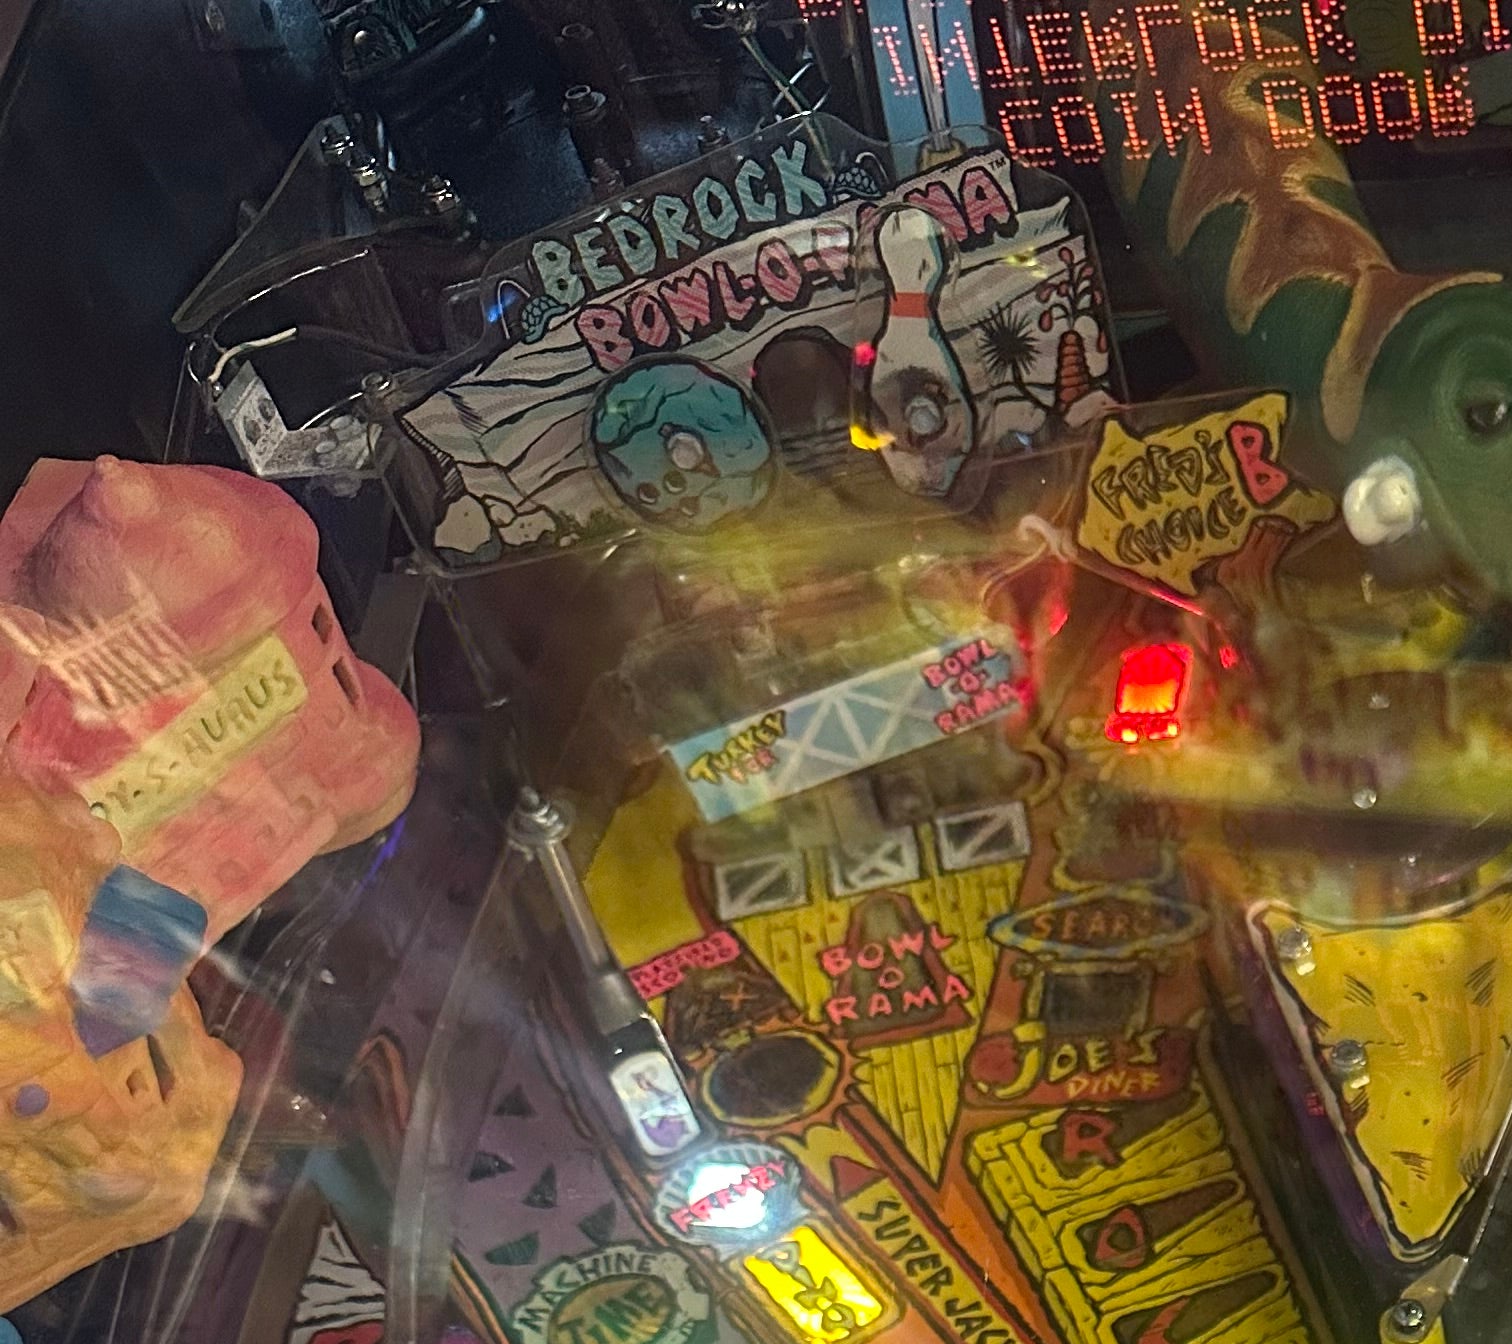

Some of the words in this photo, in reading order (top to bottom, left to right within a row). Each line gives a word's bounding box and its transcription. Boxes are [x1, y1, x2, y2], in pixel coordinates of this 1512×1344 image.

[531, 140, 827, 304] BEDROCK
[1116, 486, 1247, 566] CHOICE
[821, 923, 956, 976] BOWL
[826, 974, 971, 1026] RAMA
[1065, 1068, 1161, 1100] DINER
[858, 1200, 956, 1298] SUPER
[518, 1252, 658, 1332] MACHINE
